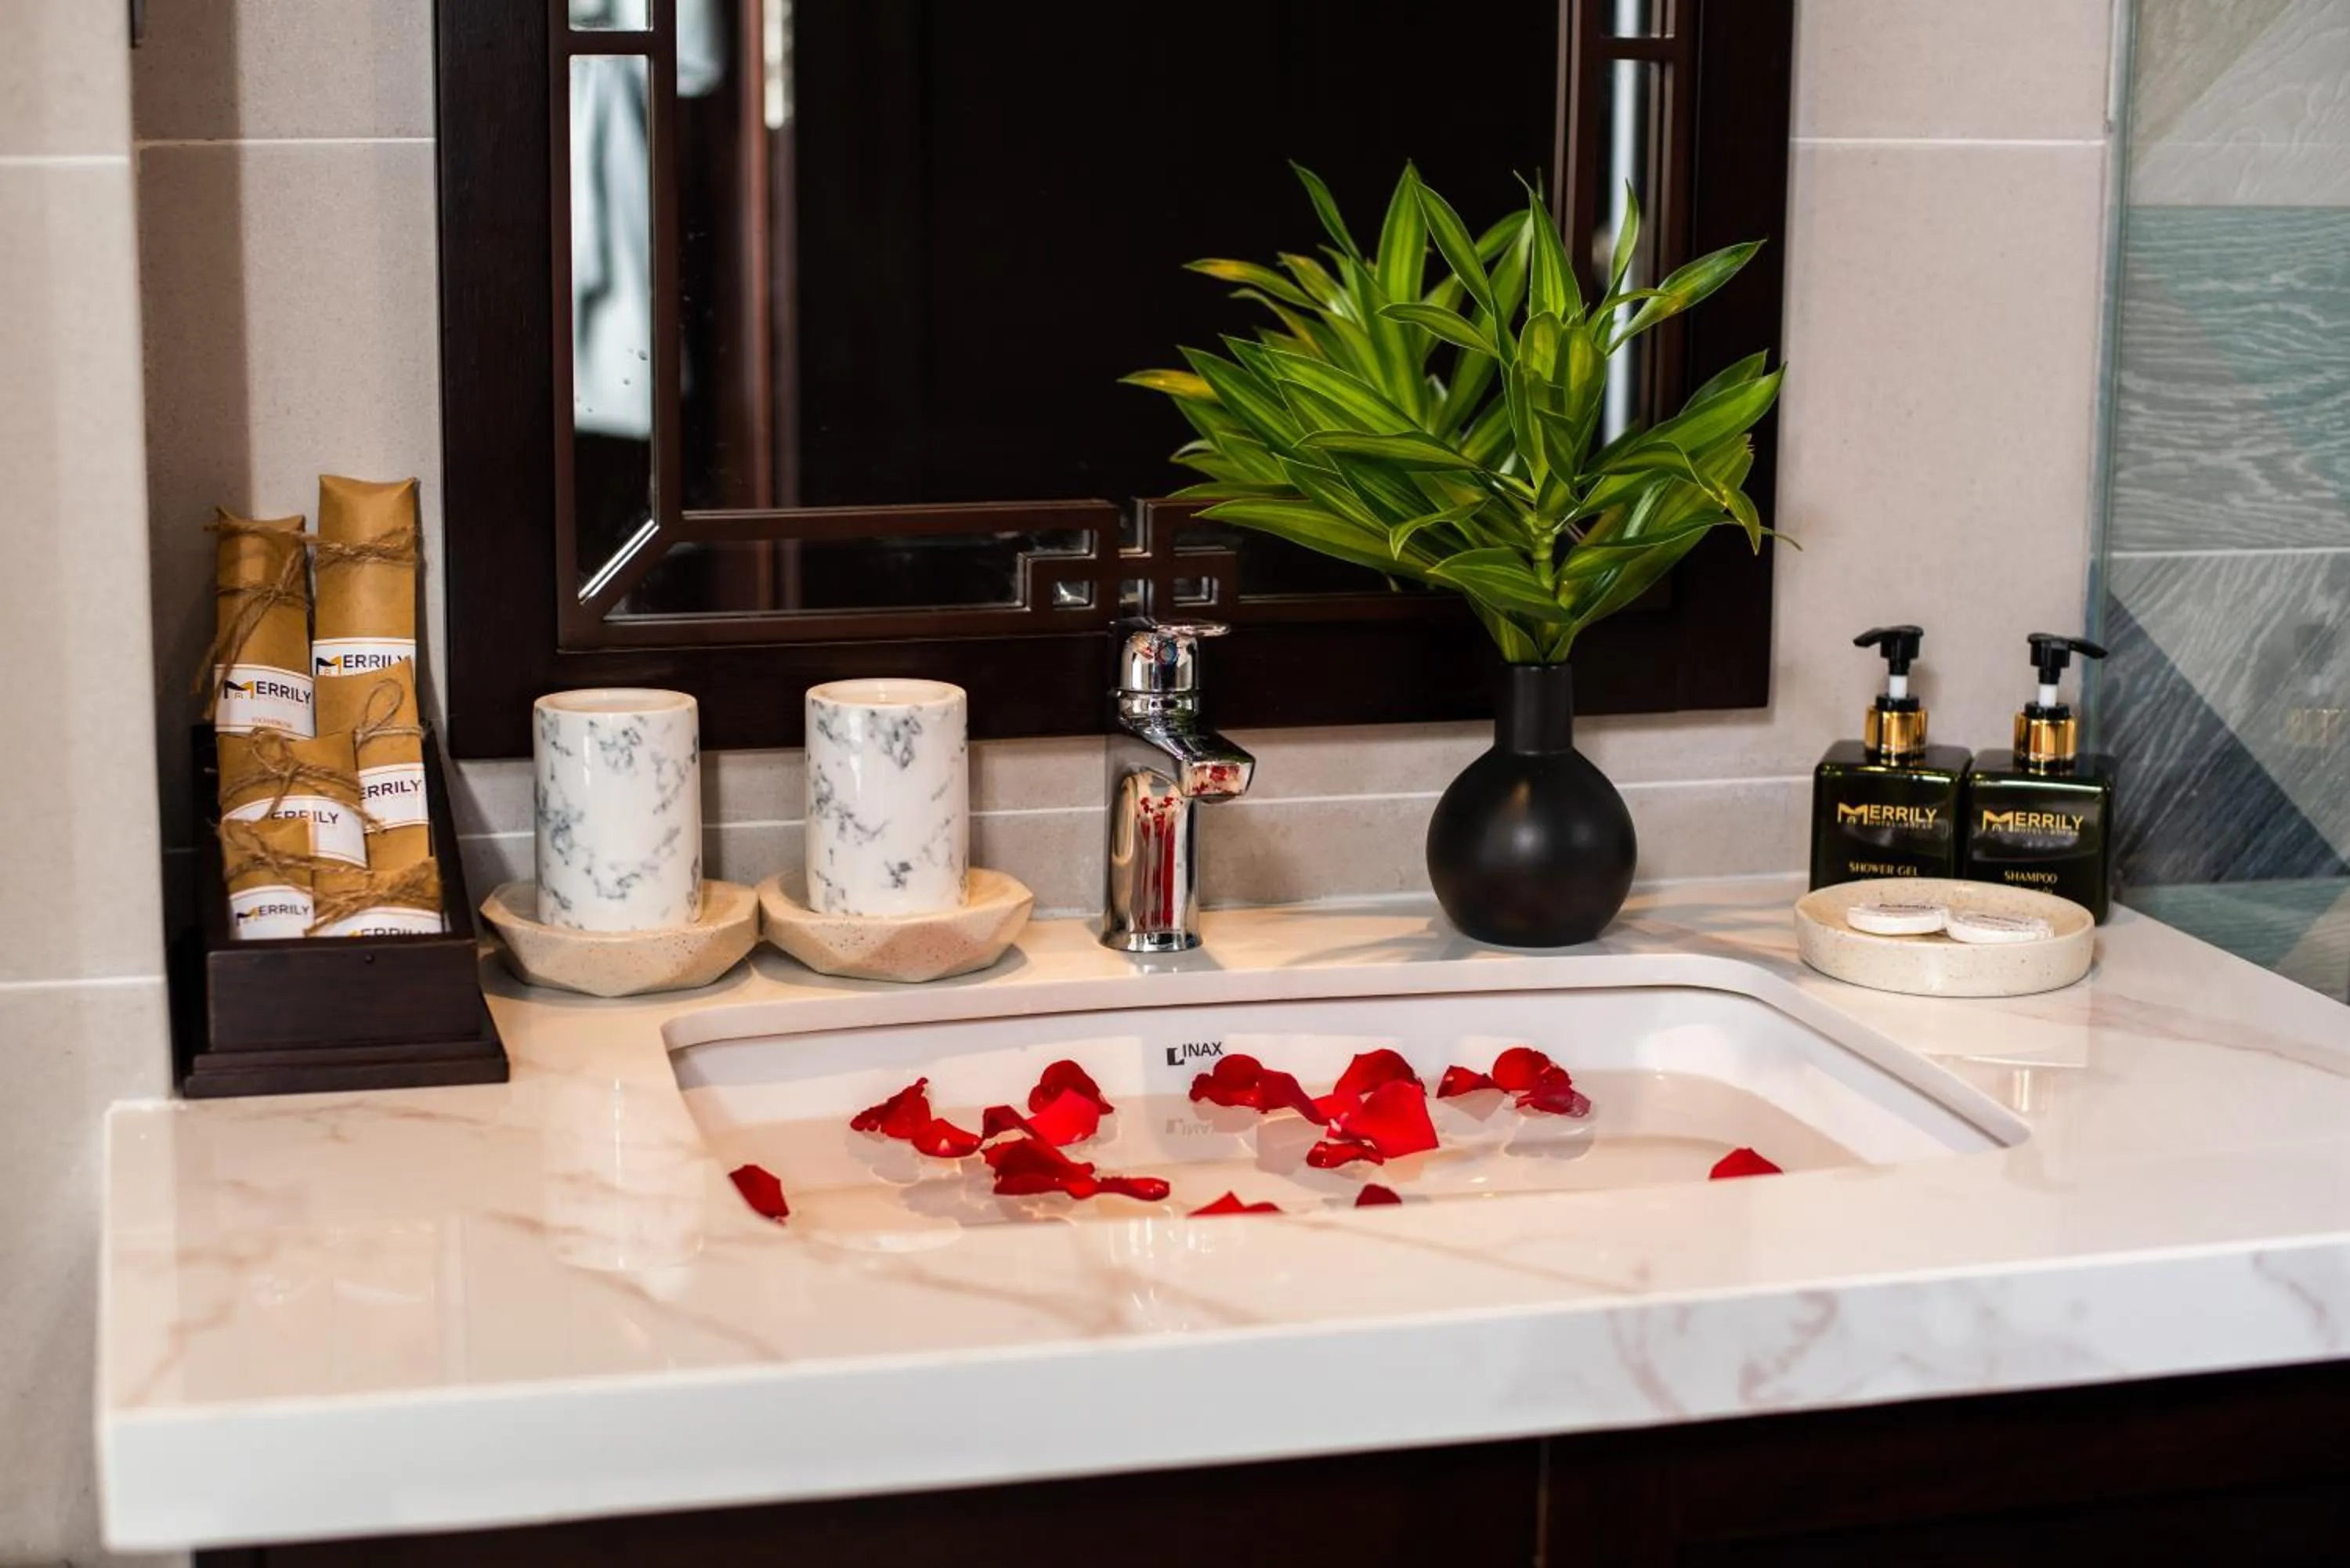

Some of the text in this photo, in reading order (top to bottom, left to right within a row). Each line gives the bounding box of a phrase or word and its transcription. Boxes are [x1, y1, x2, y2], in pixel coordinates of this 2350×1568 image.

[316, 655, 402, 675] MERRIL
[223, 680, 311, 704] MERRILY
[360, 779, 421, 800] ERRILY
[270, 810, 338, 824] ERRILY
[1837, 802, 1937, 826] MERRILY
[1983, 809, 2084, 833] MERRILY
[1849, 862, 1918, 876] SHOWER GEL
[2004, 870, 2059, 884] SHAMPOO
[237, 903, 309, 926] MERRILY
[1182, 1042, 1223, 1057] INAX
